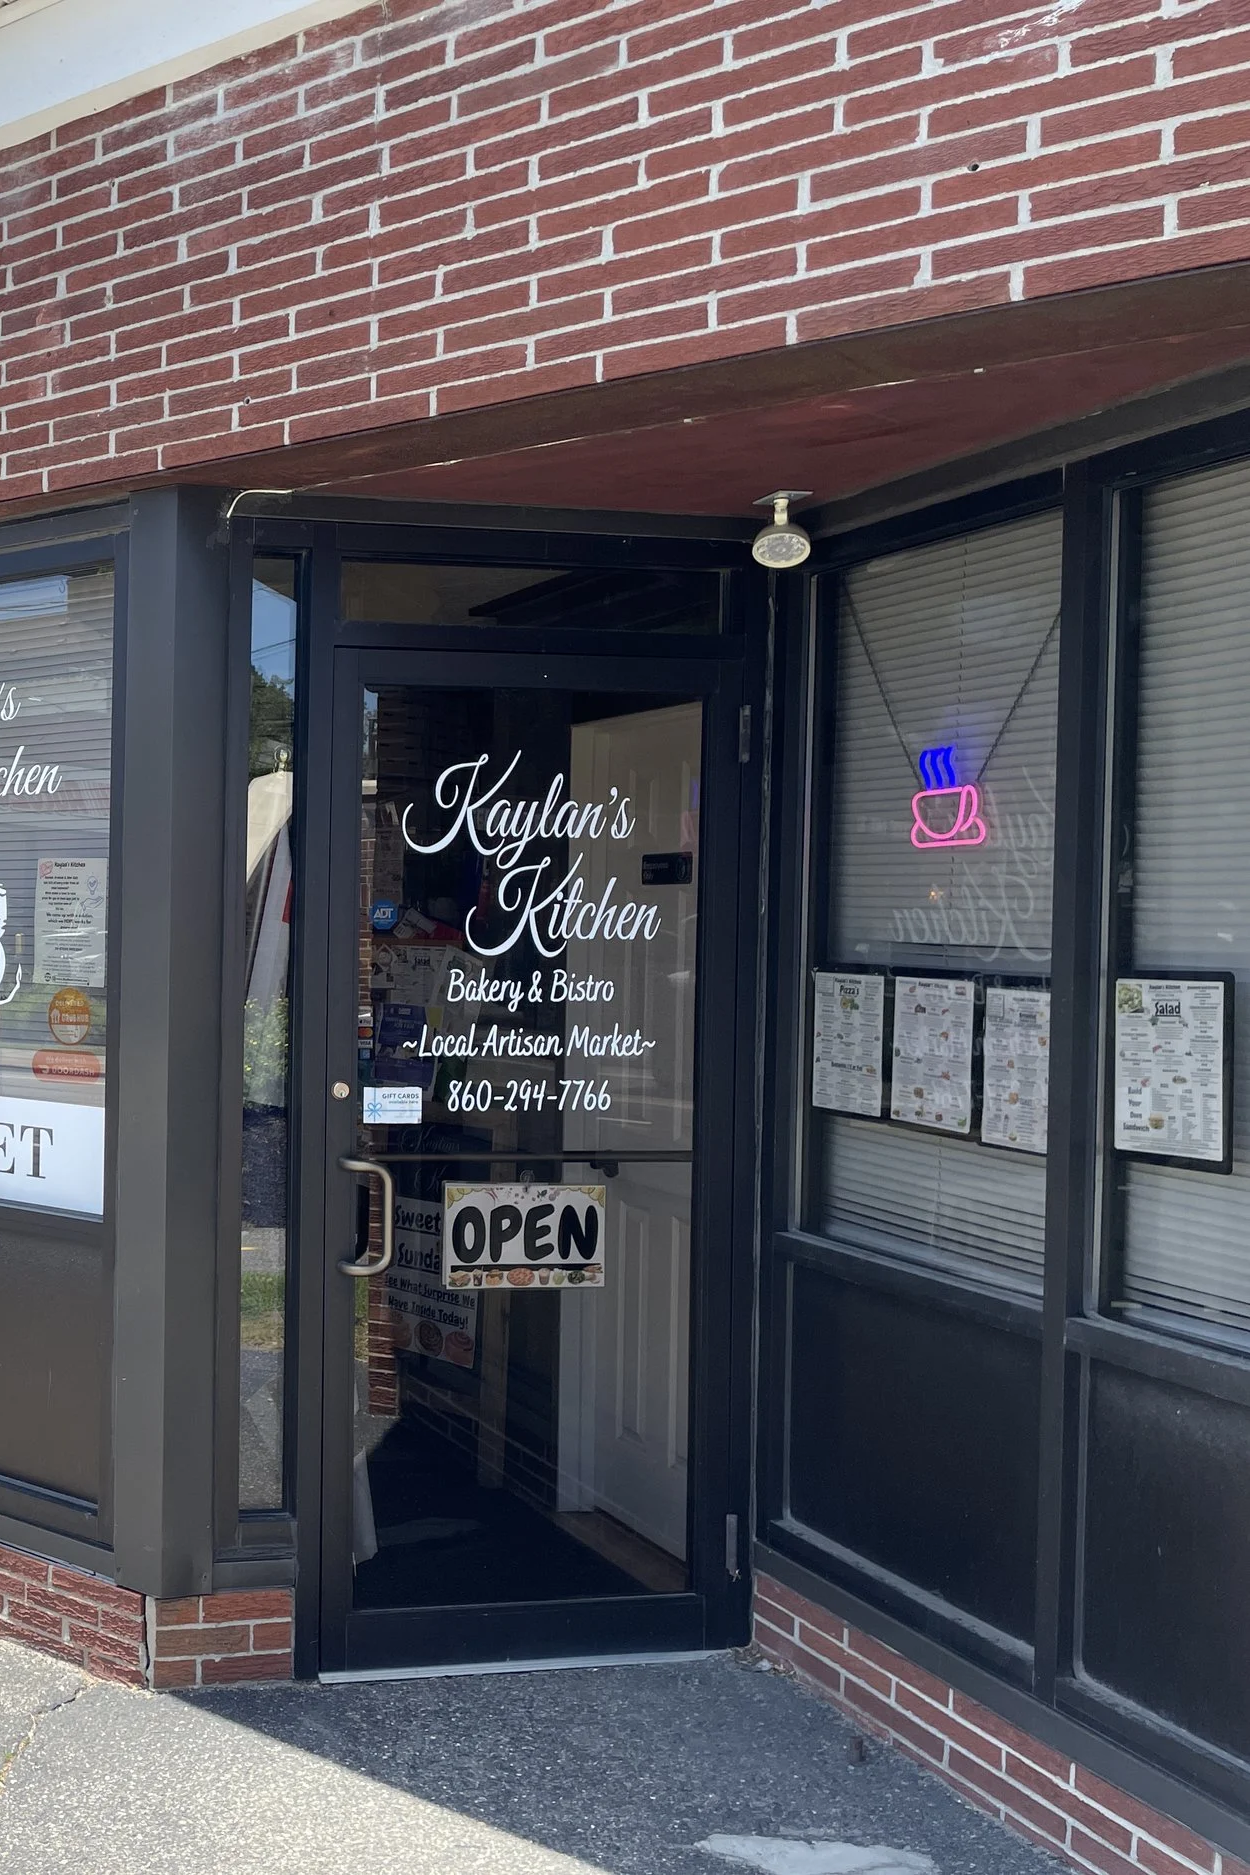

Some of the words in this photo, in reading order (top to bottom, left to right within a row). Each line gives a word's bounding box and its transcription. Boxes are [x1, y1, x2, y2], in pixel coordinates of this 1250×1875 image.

[402, 749, 636, 870] Kaylan's
[374, 908, 394, 919] ADT
[465, 852, 662, 958] Kitchen
[446, 968, 524, 1013] Bakery
[527, 970, 543, 1003] &
[550, 968, 615, 1003] Bistro
[1155, 1001, 1181, 1015] Salad
[481, 1023, 563, 1058] Artisan
[52, 1066, 95, 1076] DOORDASH
[447, 1079, 612, 1113] 860-294-7766
[395, 1204, 442, 1234] Sweet
[451, 1204, 599, 1264] OPEN
[397, 1242, 440, 1271] Sunda
[400, 1278, 423, 1295] What
[424, 1283, 460, 1304] Surprise
[438, 1309, 469, 1330] Today!
